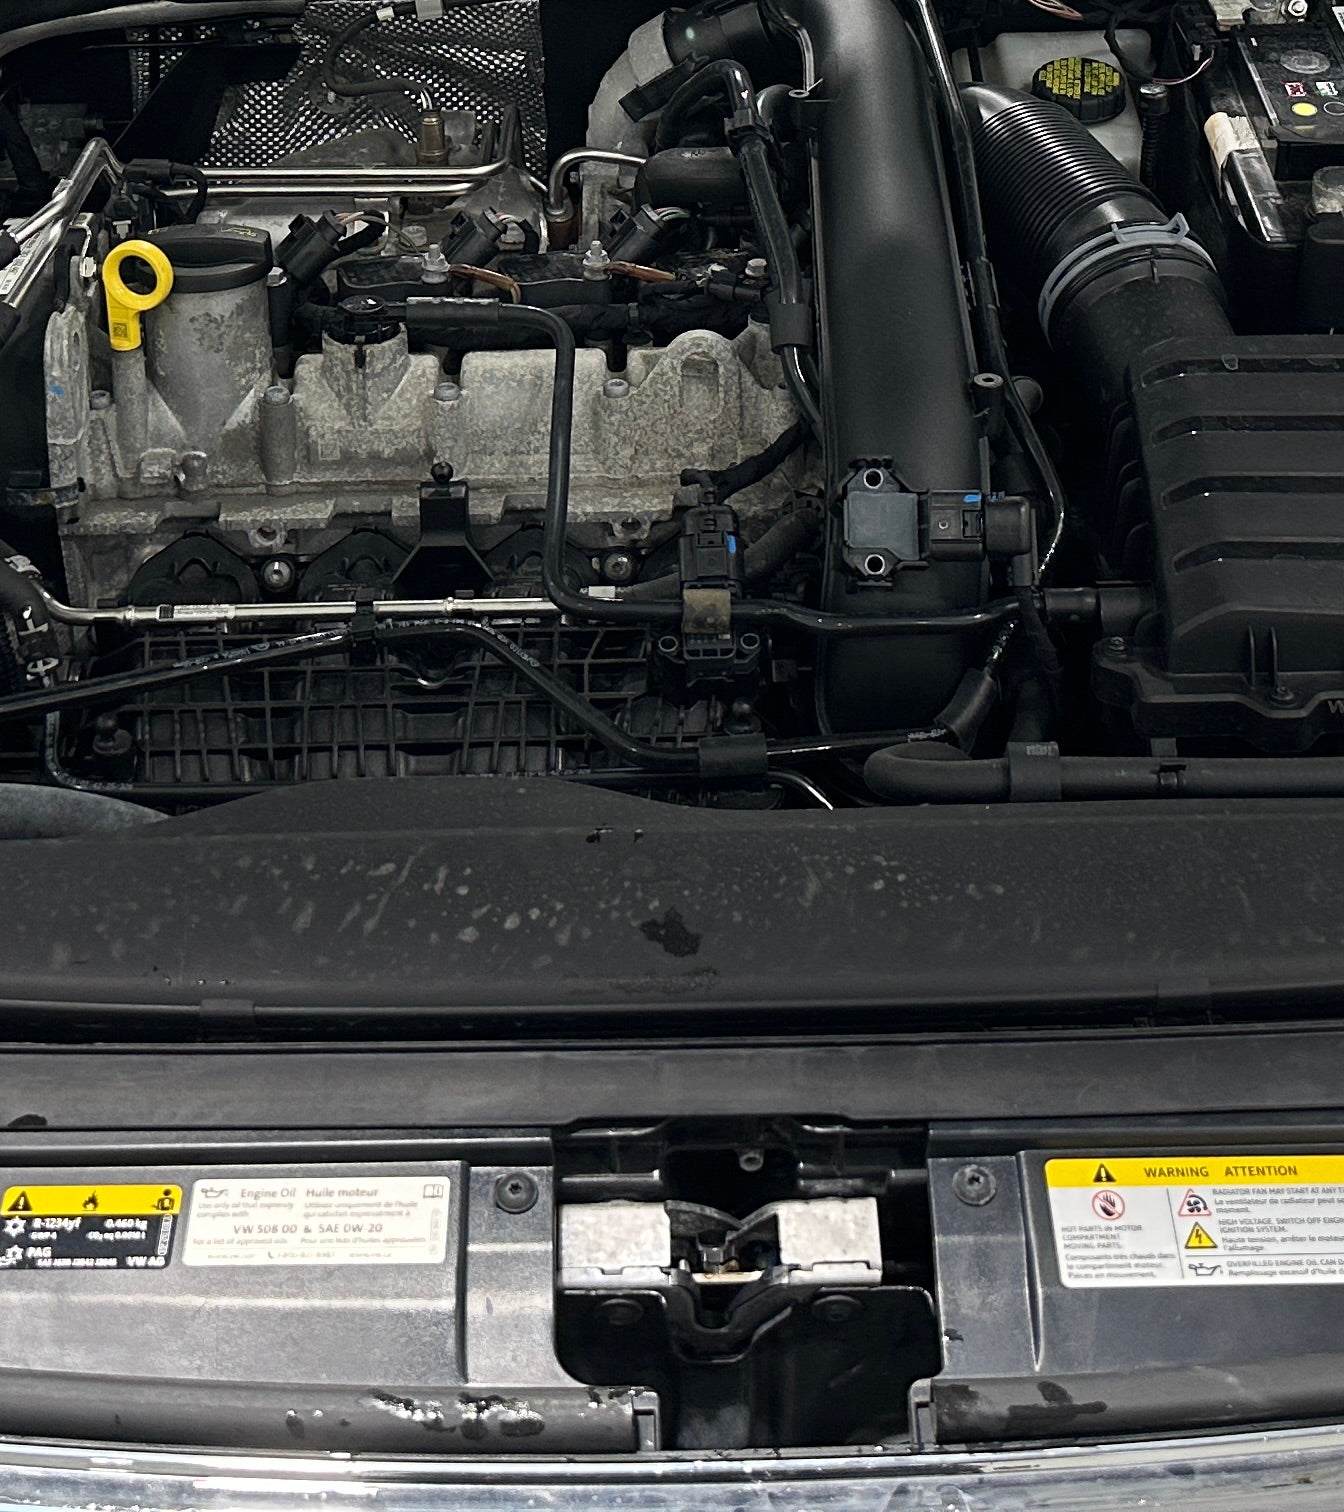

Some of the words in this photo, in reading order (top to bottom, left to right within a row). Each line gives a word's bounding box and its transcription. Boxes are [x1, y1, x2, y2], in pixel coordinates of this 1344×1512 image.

[1144, 1166, 1209, 1178] WARNING
[1225, 1165, 1298, 1176] ATTENTION
[240, 1188, 278, 1200] Engine
[280, 1187, 297, 1198] Oil
[306, 1187, 335, 1198] Huile
[338, 1187, 378, 1197] moteur
[233, 1224, 254, 1234] VW
[282, 1224, 298, 1234] 00
[303, 1224, 312, 1234] &
[318, 1223, 340, 1233] SAE
[26, 1246, 52, 1258] PAG
[126, 1256, 147, 1267] VW
[148, 1256, 165, 1267] AG
